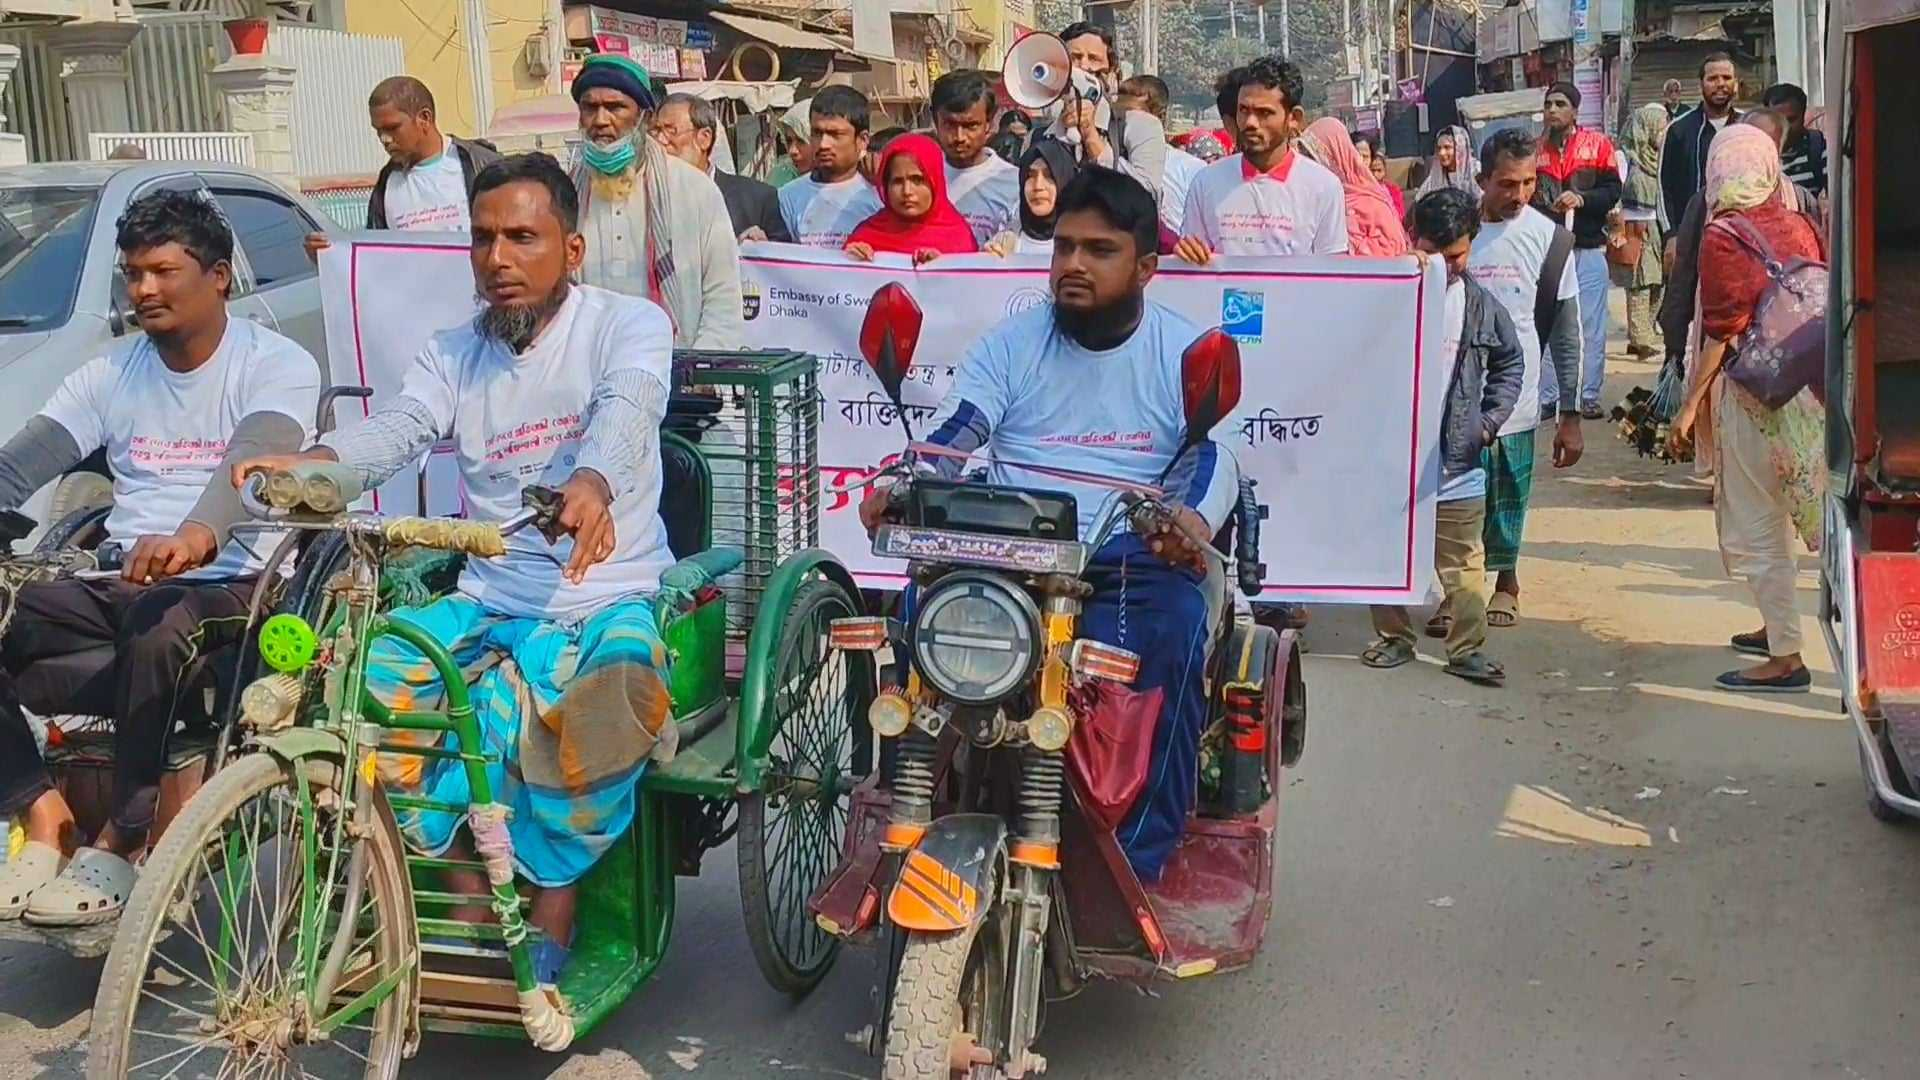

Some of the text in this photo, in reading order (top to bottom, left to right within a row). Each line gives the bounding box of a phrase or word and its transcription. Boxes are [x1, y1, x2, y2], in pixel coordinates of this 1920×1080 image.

[769, 287, 823, 306] Embassy
[827, 294, 841, 305] of
[769, 303, 808, 319] Dhaka
[1240, 408, 1323, 448] বৃদ্ধিতে
